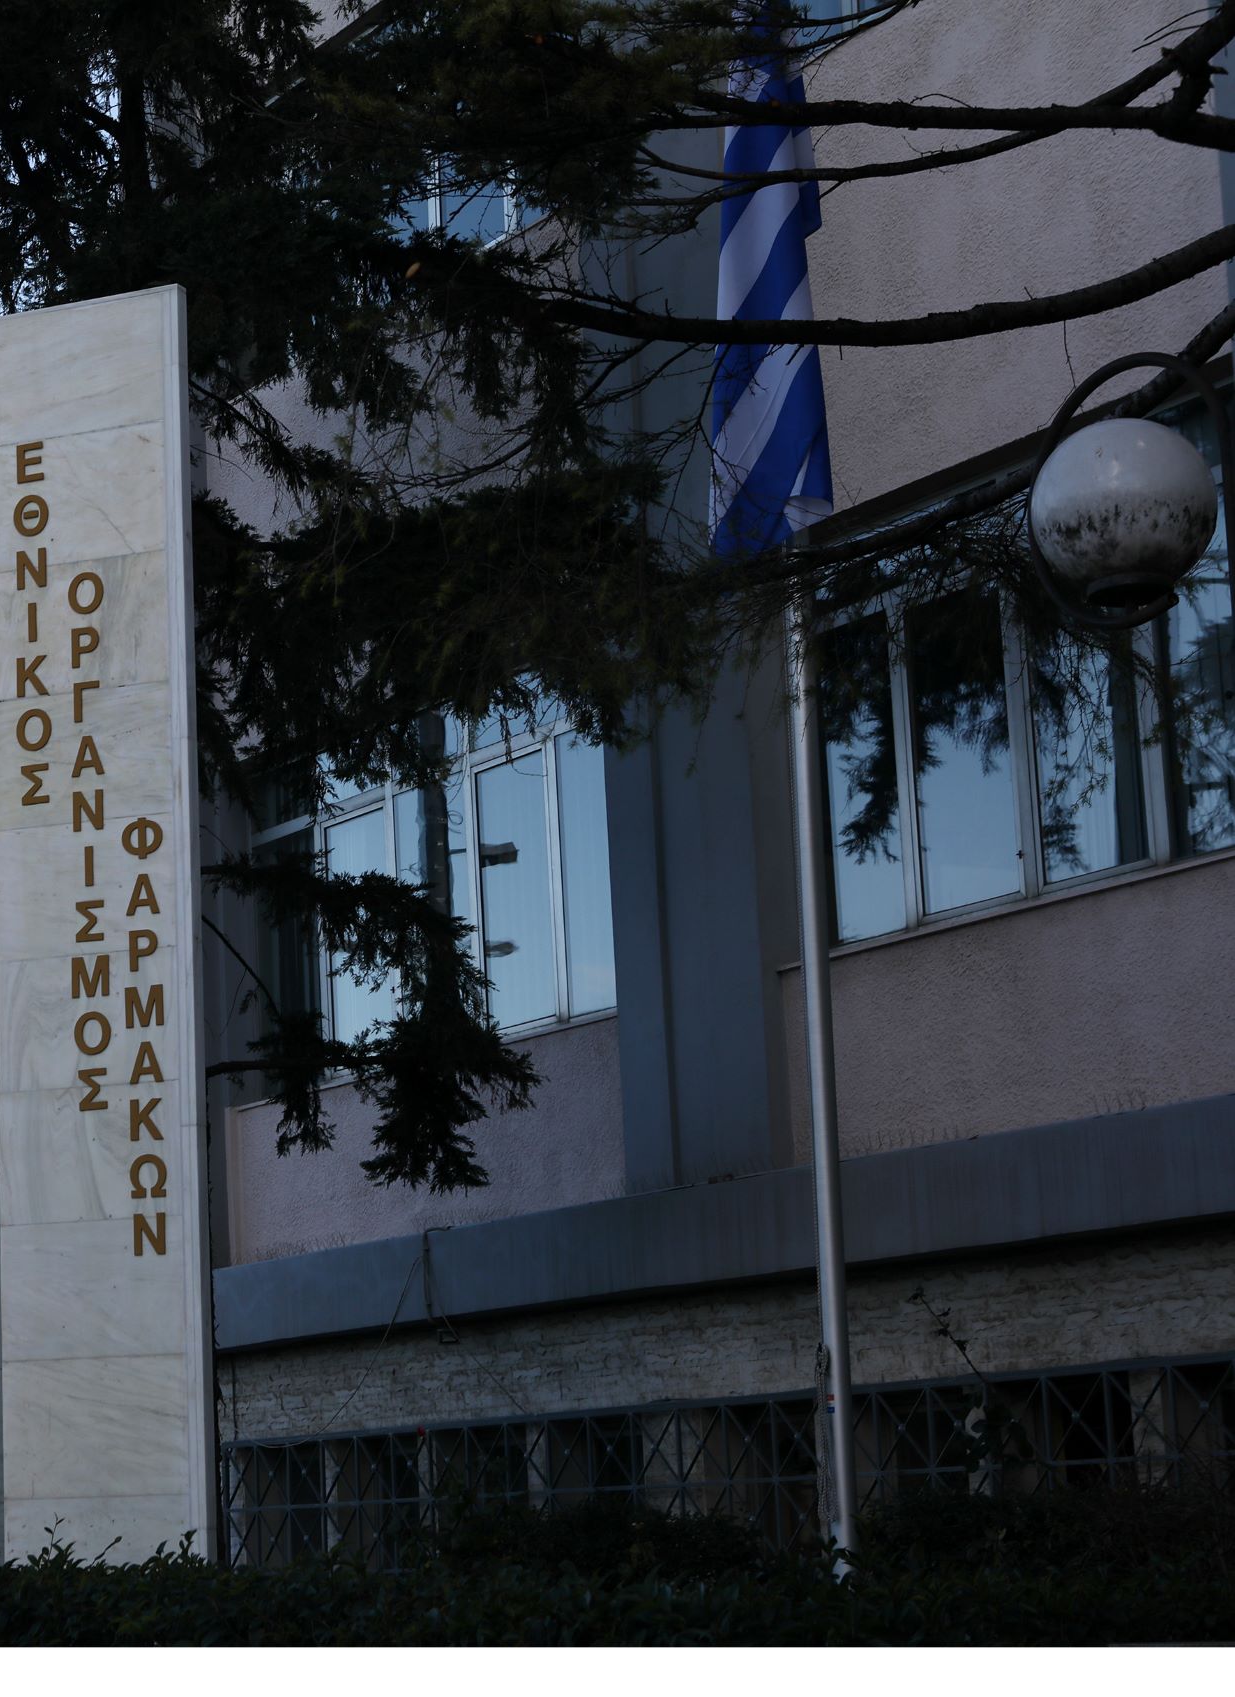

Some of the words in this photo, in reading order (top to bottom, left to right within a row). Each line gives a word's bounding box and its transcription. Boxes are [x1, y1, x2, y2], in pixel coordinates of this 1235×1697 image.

[13, 441, 52, 806] ΕΘΝΙΚΟΣ
[68, 572, 111, 1112] ΟΡΓΑΝΙΣΜΟΣ
[122, 817, 168, 1257] ΦΑΡΜΑΚΩΝ
